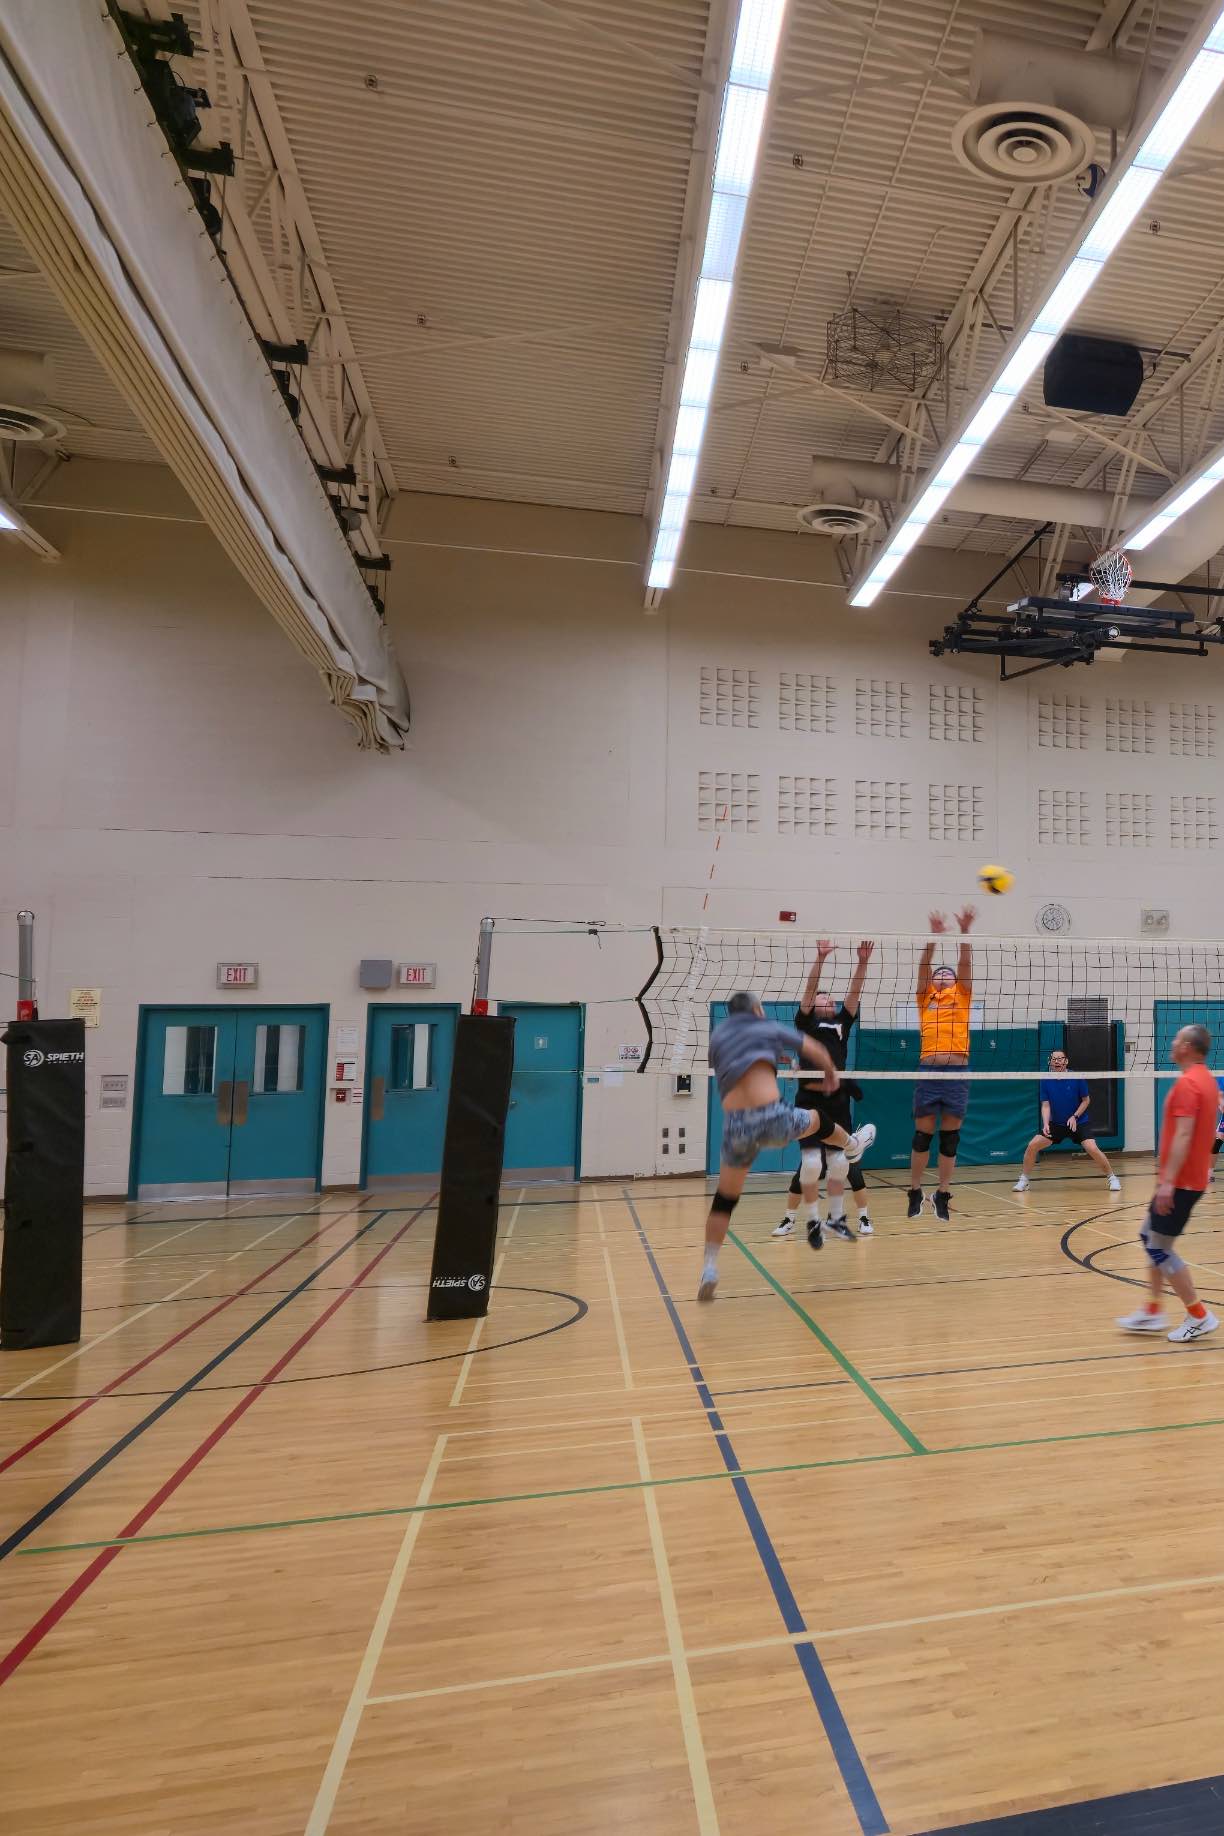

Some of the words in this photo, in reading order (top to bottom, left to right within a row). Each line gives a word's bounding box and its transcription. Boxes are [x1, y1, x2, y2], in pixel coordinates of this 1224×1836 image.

[226, 967, 248, 983] EXIT
[406, 967, 426, 982] EXIT
[45, 1051, 84, 1061] SPIETH
[432, 1279, 467, 1288] SPIETH
